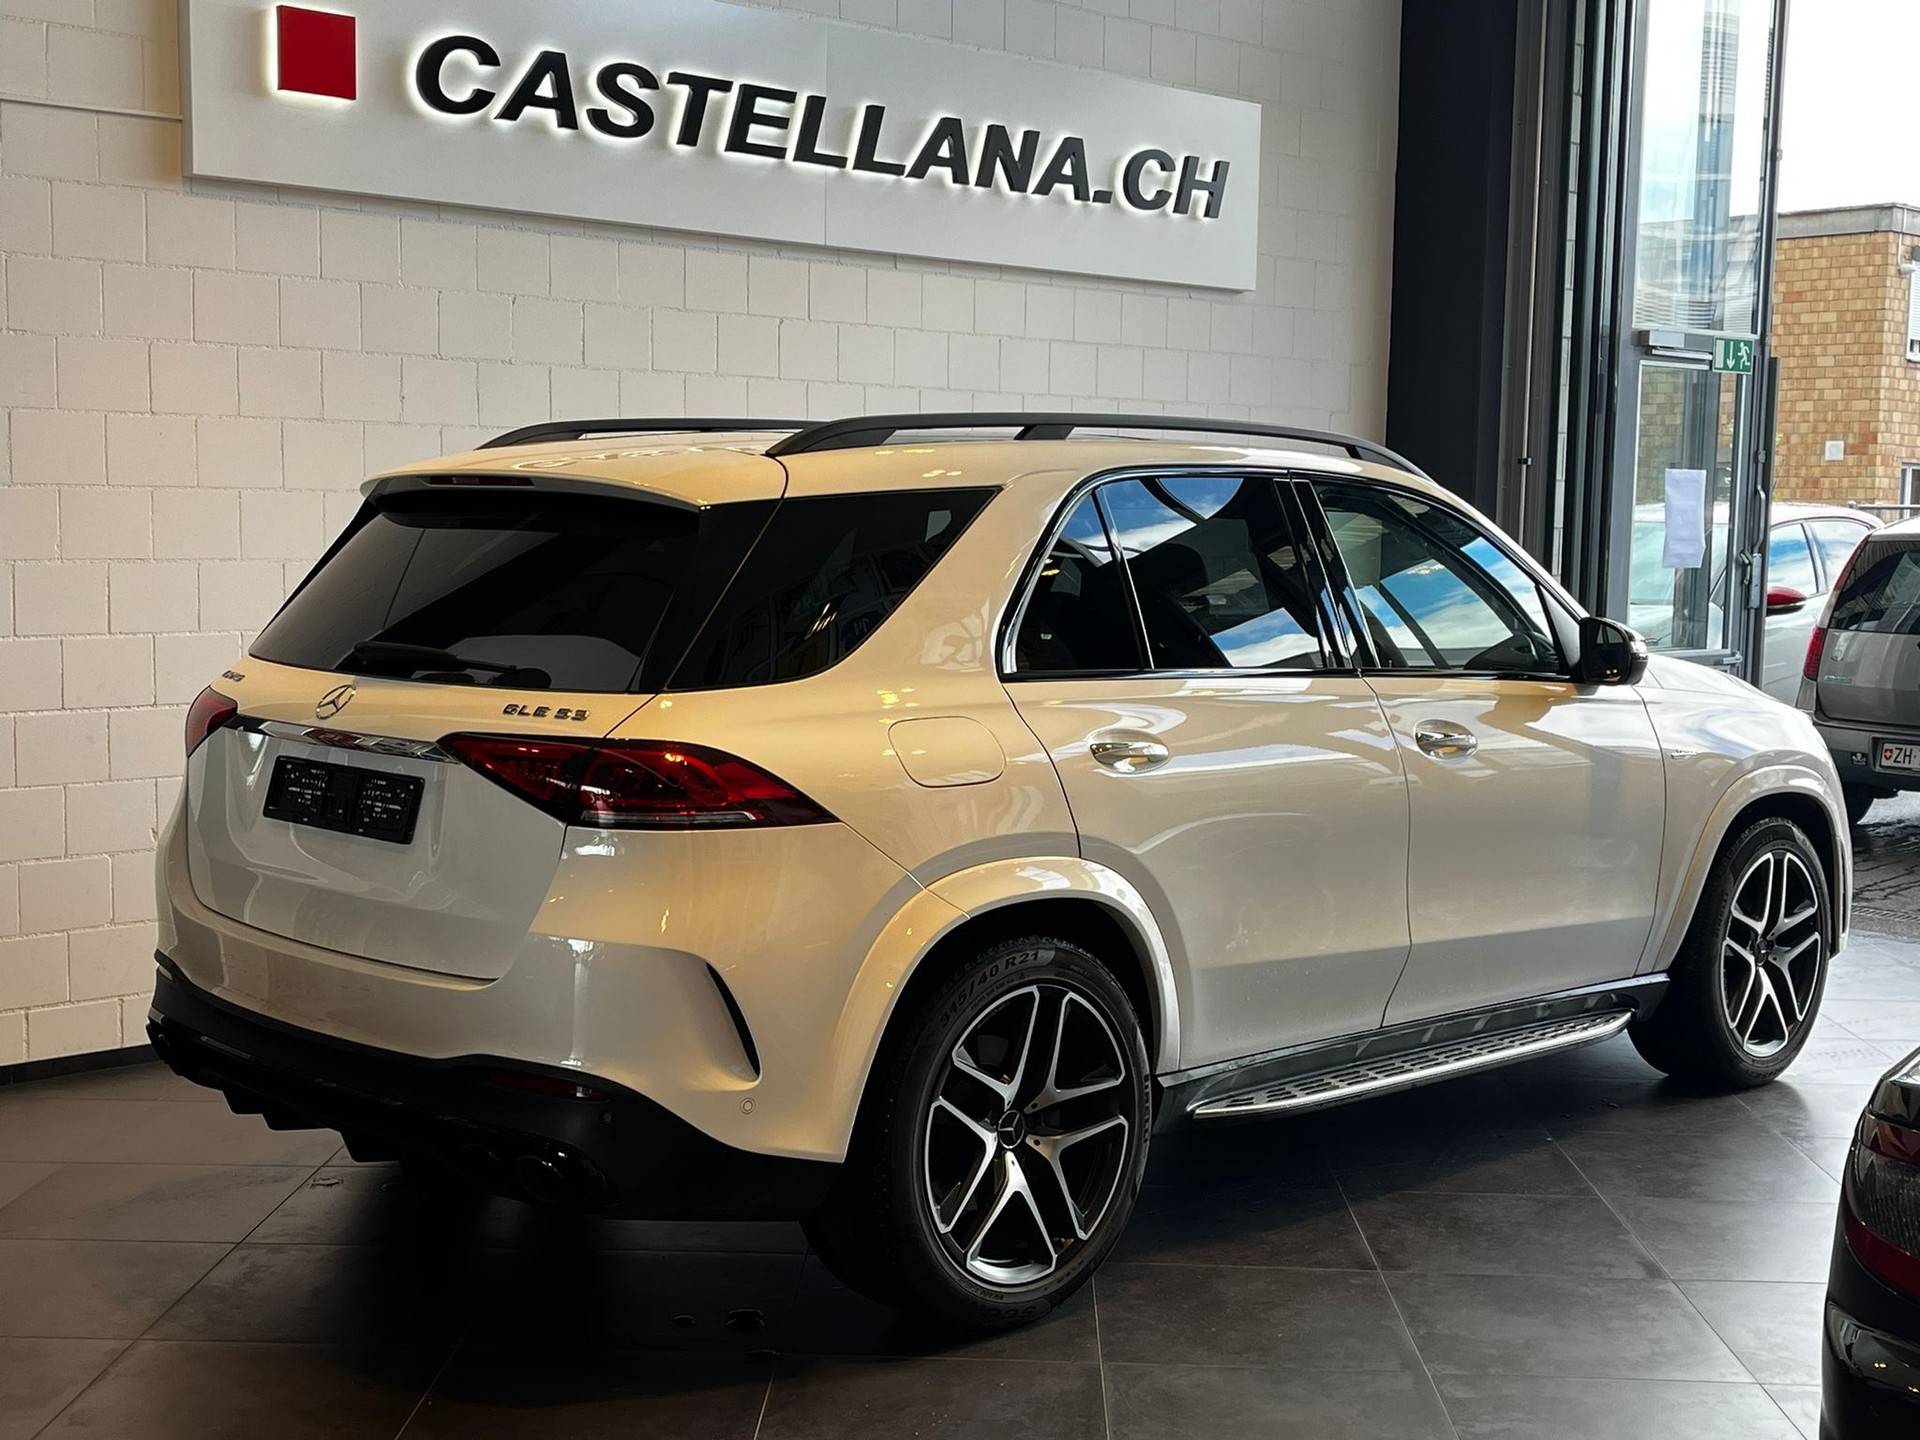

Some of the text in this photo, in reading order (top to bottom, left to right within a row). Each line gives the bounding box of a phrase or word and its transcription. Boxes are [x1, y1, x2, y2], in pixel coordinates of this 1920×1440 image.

[414, 34, 1230, 219] CASTELLANA.CH
[502, 703, 591, 722] GLE 53
[1004, 950, 1039, 970] R21
